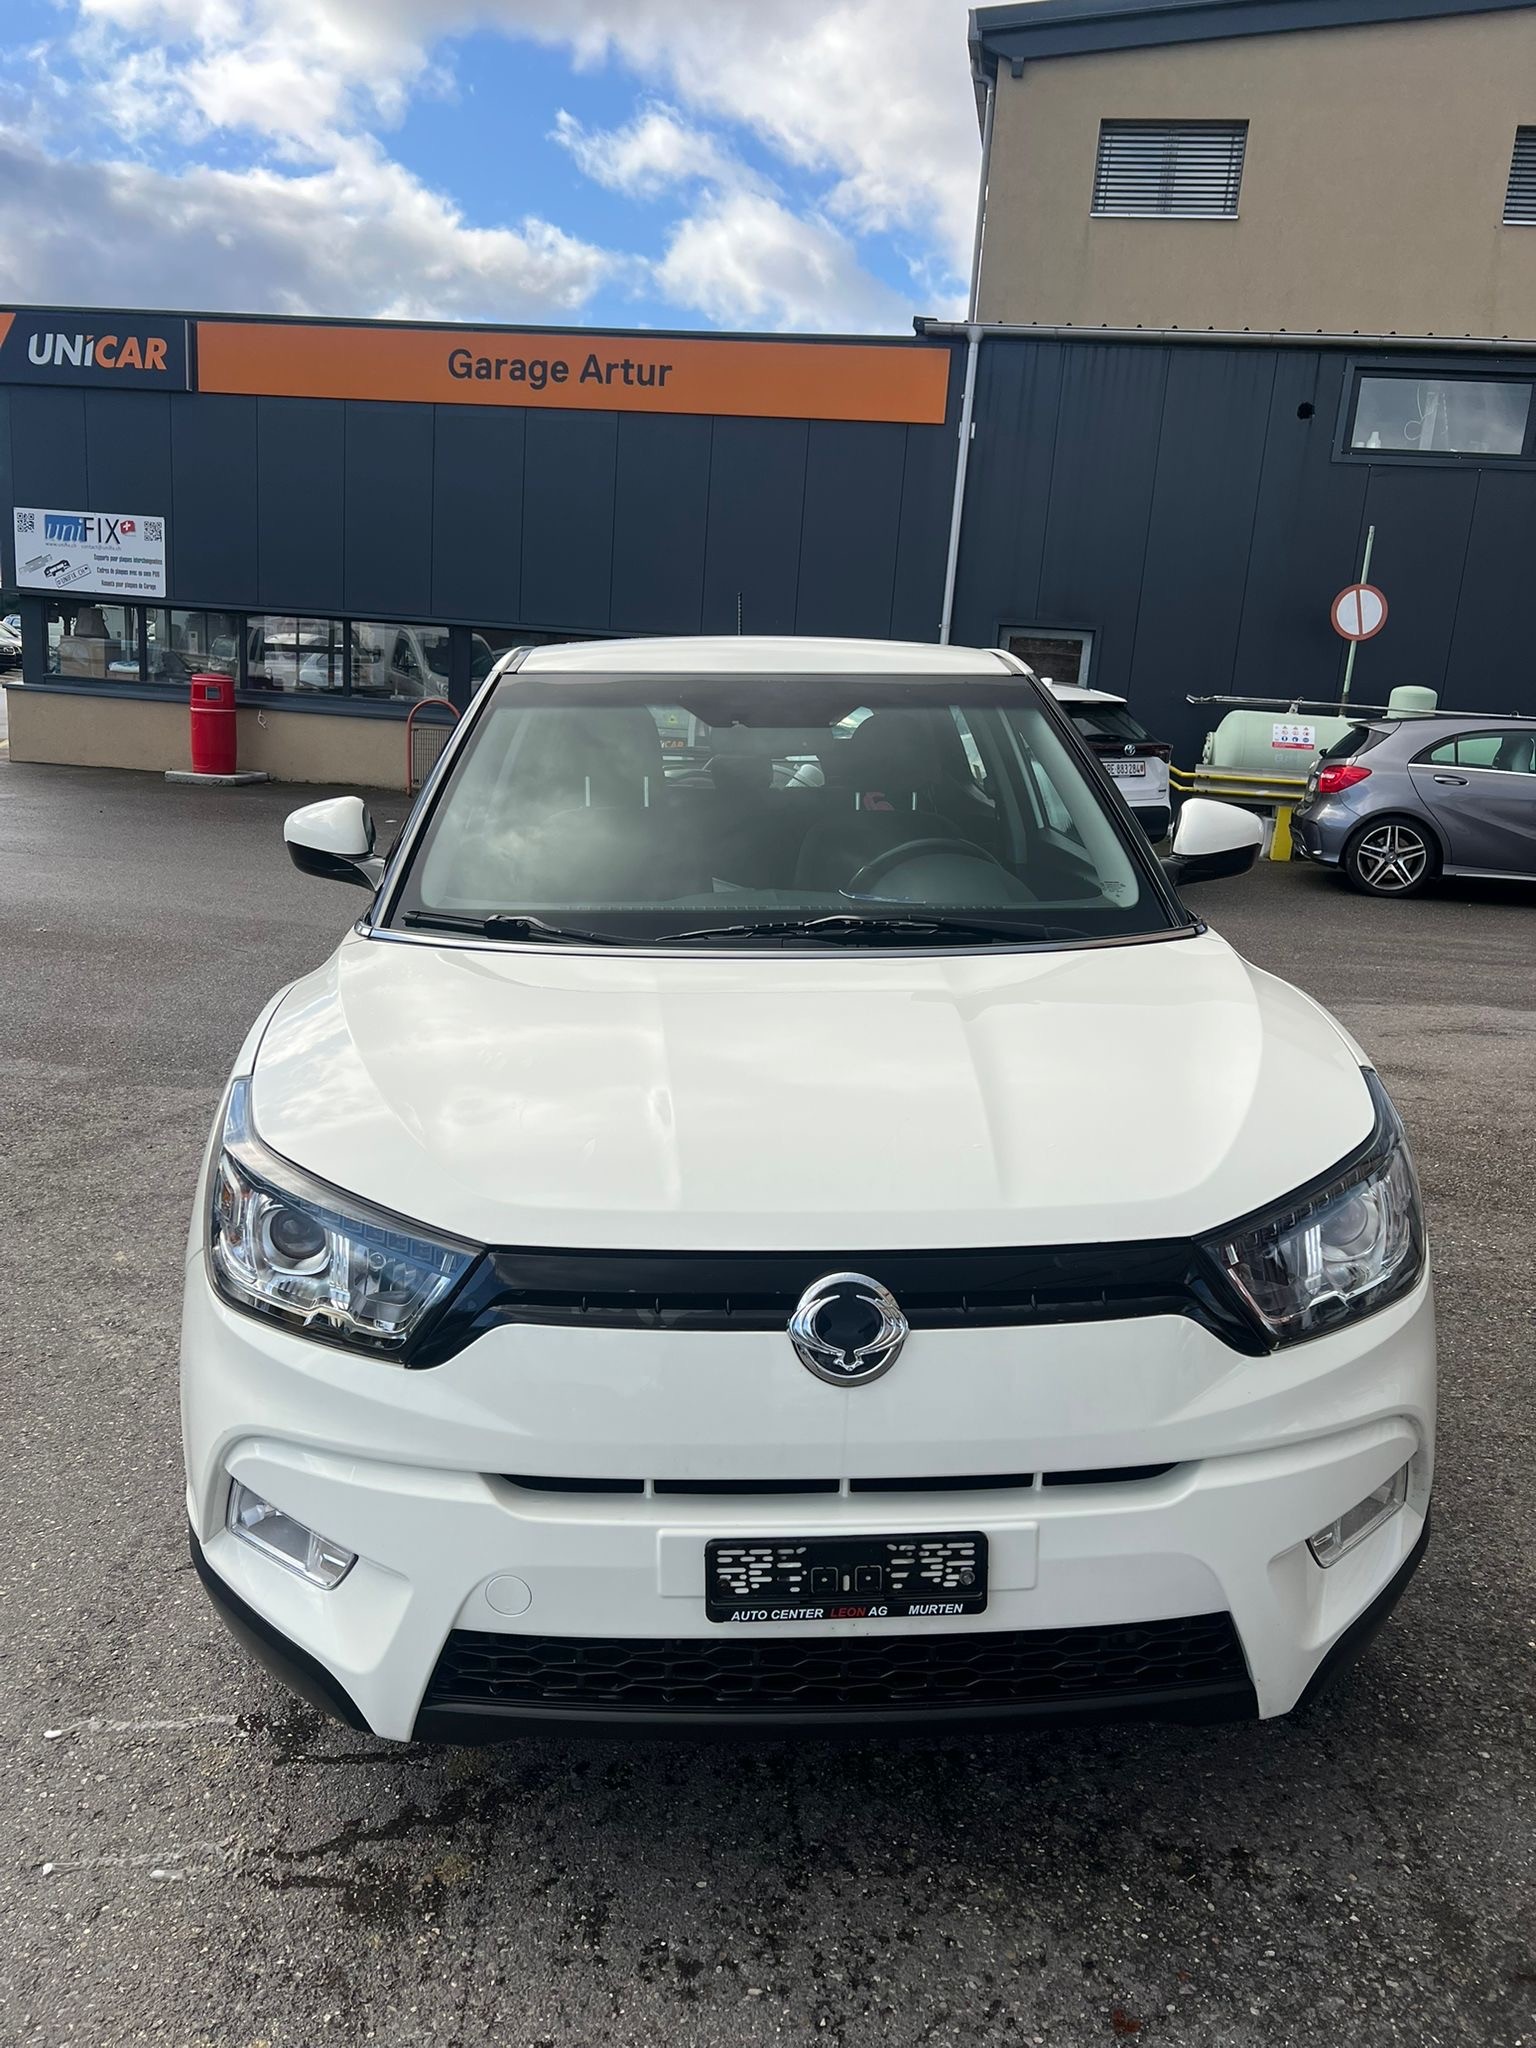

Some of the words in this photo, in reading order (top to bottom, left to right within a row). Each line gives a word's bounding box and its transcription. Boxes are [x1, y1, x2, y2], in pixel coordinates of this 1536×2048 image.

[448, 348, 569, 390] Garage
[579, 353, 673, 388] Artur
[731, 1610, 768, 1622] AUTO
[771, 1608, 824, 1619] CENTER
[830, 1606, 866, 1618] LEON
[868, 1606, 888, 1617] AG
[908, 1603, 964, 1615] MURTEN
